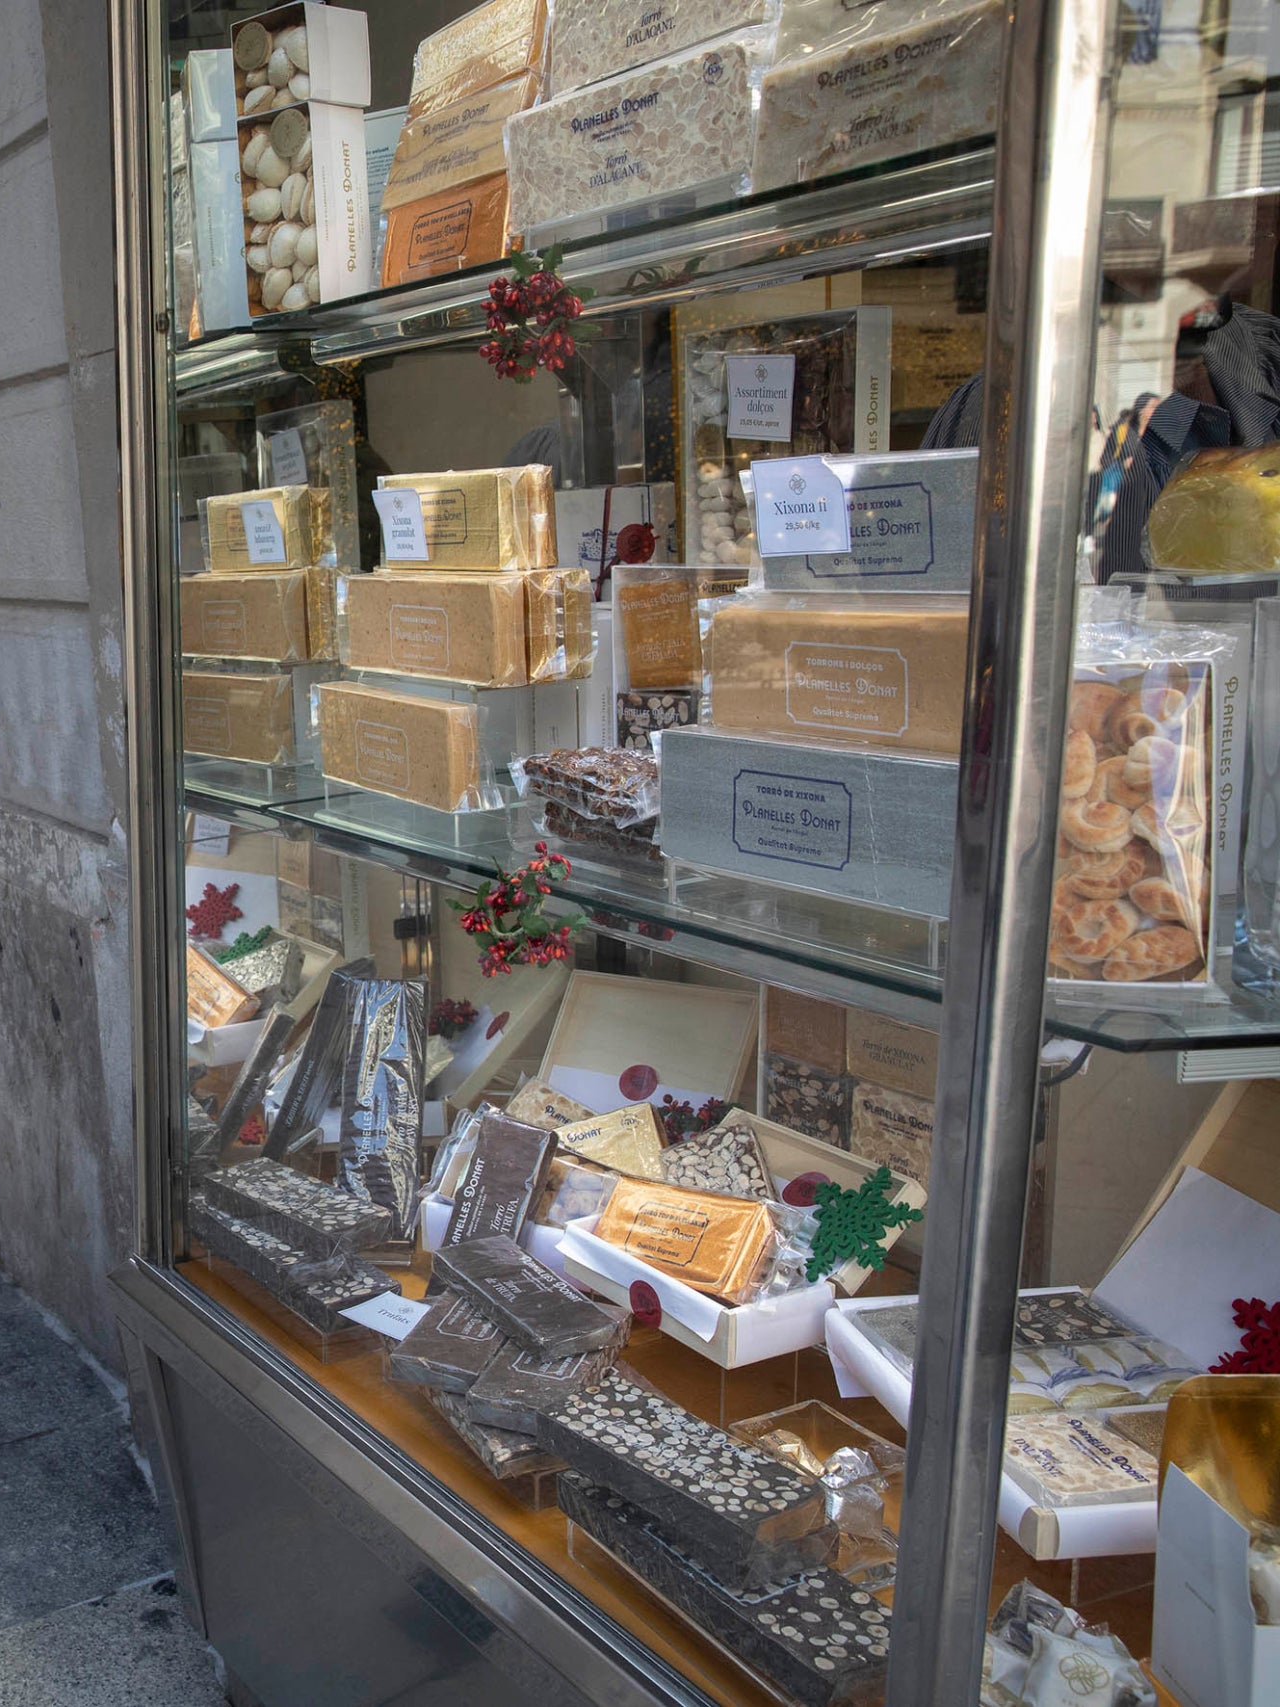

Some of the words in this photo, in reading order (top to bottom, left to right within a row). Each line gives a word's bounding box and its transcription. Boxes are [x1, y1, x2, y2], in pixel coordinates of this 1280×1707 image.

[817, 54, 889, 90] PLANELLES
[894, 32, 956, 65] DONAT
[422, 116, 459, 136] PLANELLES
[462, 104, 491, 122] DONAT
[571, 106, 619, 134] PLANELLES
[621, 92, 659, 115] DONAT
[341, 140, 353, 193] DONAT
[347, 198, 357, 272] PLANELLES
[734, 386, 788, 399] Assortiment
[867, 375, 879, 425] DONAT
[747, 399, 774, 415] dolços
[774, 501, 816, 516] Xixona
[818, 498, 827, 513] fi
[869, 499, 903, 509] XIXONA
[876, 518, 921, 537] DONAT
[805, 657, 844, 668] TORRONS
[849, 662, 884, 673] DOLÇOS
[794, 672, 851, 693] PLANELLES
[855, 677, 898, 698] DONAT
[622, 707, 651, 719] LANELLES
[812, 706, 843, 718] Qualitat
[845, 710, 879, 721] Suprema
[1219, 676, 1239, 777] PLANELLES
[756, 785, 782, 797] TORRÓ
[784, 789, 794, 797] DE
[795, 791, 826, 803] XIXONA
[742, 800, 796, 824] PLANELLES
[800, 808, 841, 832] DONAT
[1218, 782, 1233, 851] DONAT
[758, 837, 788, 850] Qualitat
[789, 842, 822, 856] Suprema
[863, 1100, 907, 1126] PLANELLES
[357, 1108, 373, 1165] PLANELLES
[449, 1201, 471, 1244] ANELLES
[463, 1157, 486, 1198] DONAT
[489, 1203, 506, 1231] Torró
[671, 1226, 696, 1242] DONAT
[519, 1254, 557, 1282] PLANELLES
[552, 1281, 584, 1302] DONAT
[377, 1308, 411, 1326] Trufats
[1067, 1418, 1114, 1456] PLANELLES
[1111, 1455, 1151, 1484] DONAT
